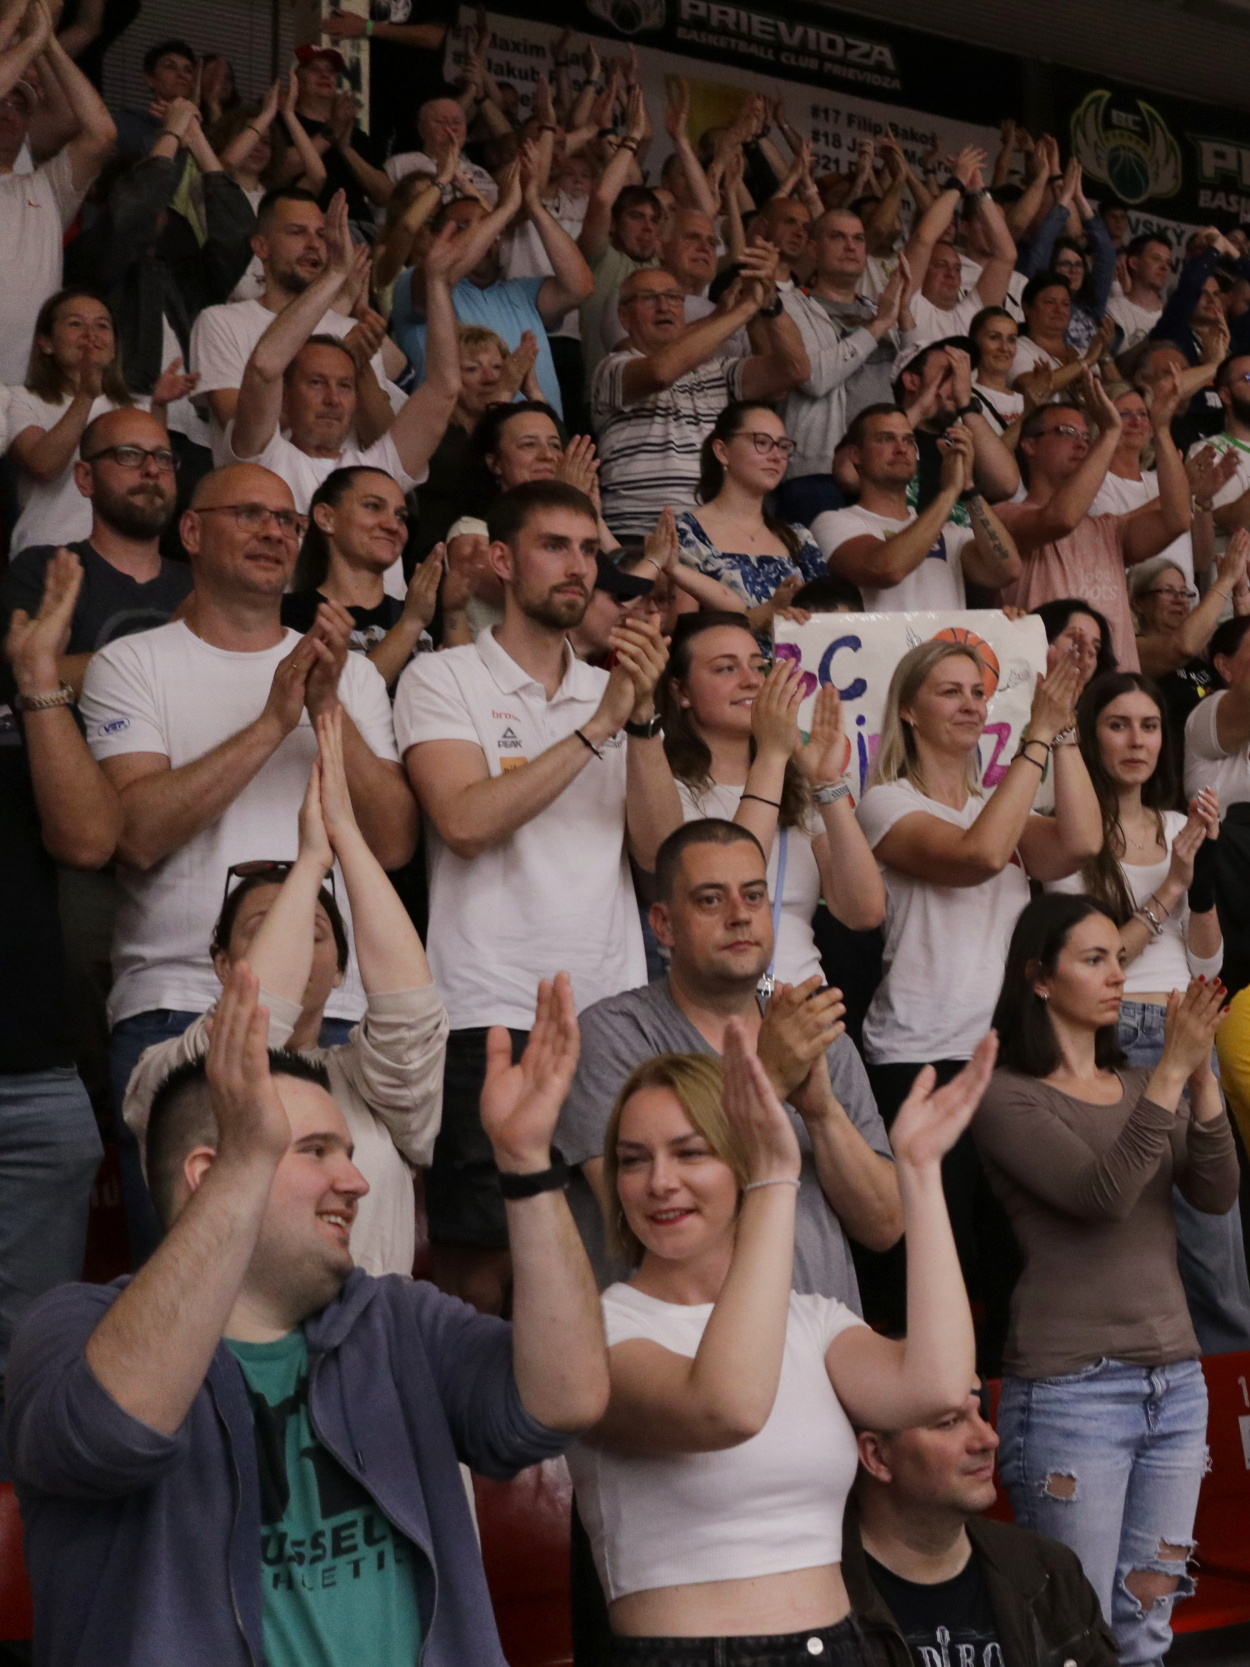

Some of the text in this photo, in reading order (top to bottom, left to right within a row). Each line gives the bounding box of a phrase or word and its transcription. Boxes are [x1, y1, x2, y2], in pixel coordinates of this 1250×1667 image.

[676, 27, 902, 91] BASKETBALL CLUB PRIEVIDZA
[679, 0, 897, 71] PRIEVIDZA
[811, 103, 841, 124] #17
[847, 113, 883, 136] Filip
[497, 740, 522, 749] PEAK
